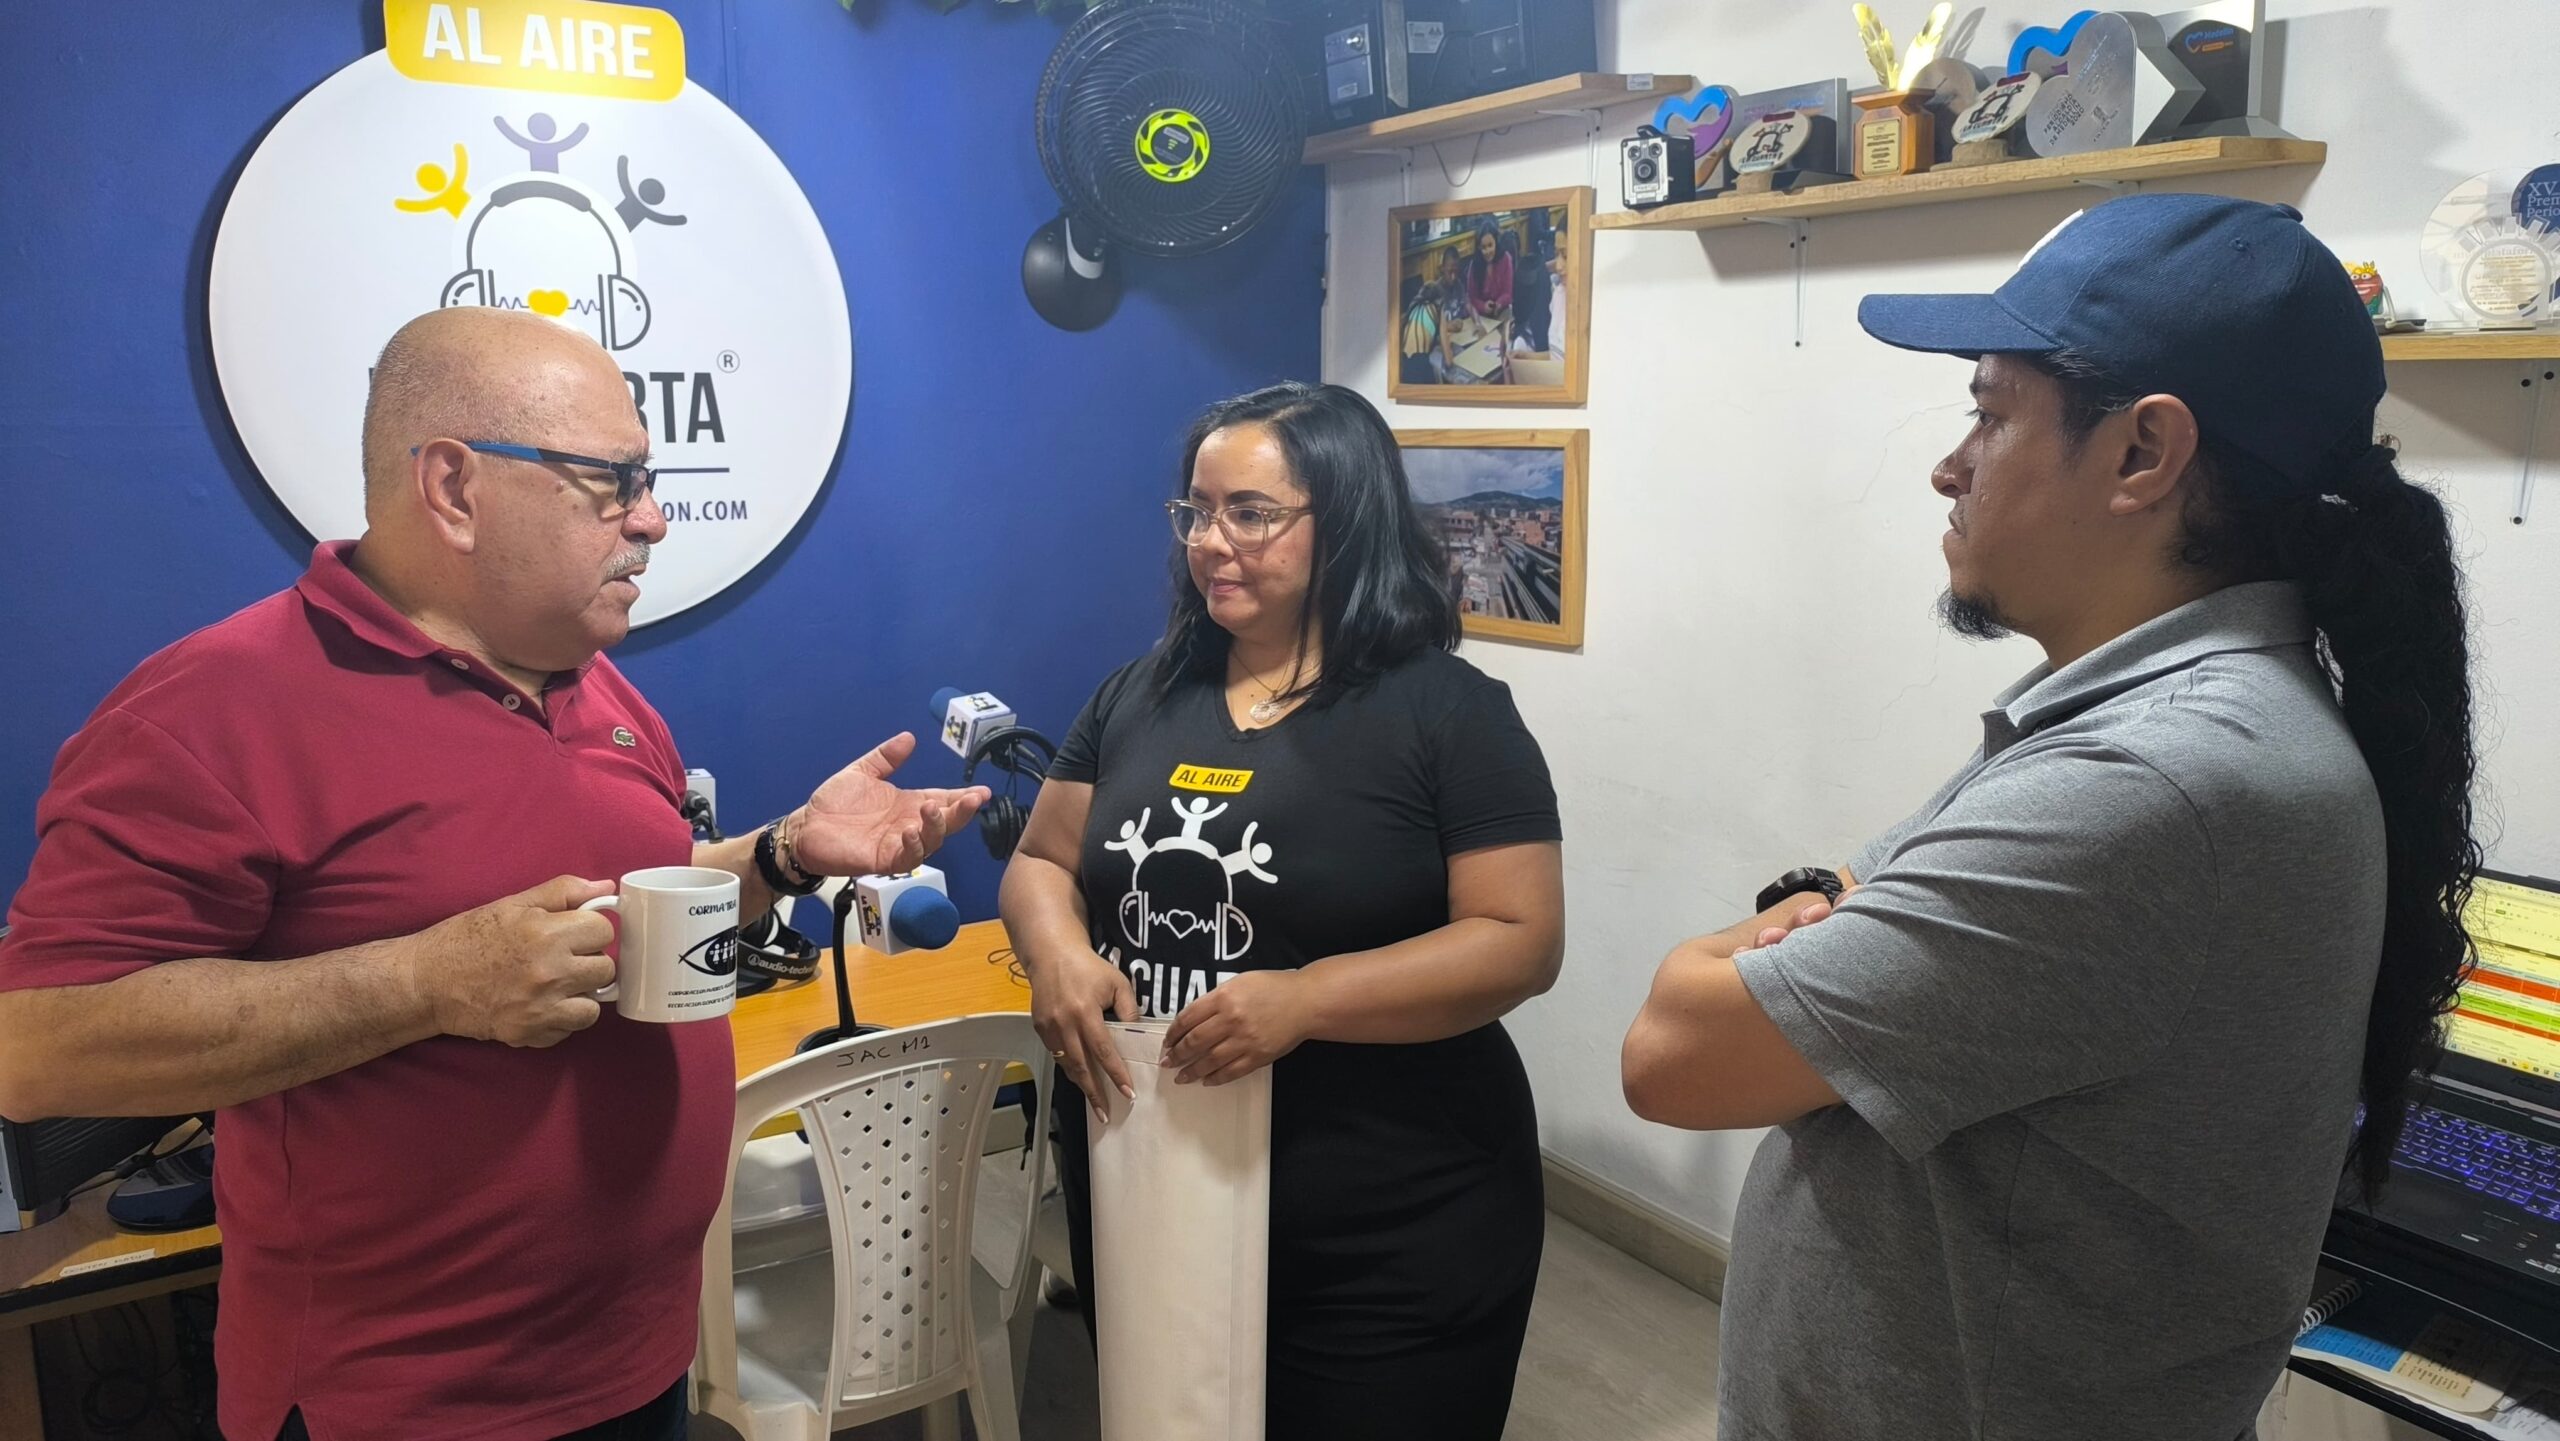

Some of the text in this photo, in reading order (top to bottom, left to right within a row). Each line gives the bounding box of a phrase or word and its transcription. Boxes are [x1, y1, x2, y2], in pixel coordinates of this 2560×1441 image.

[423, 4, 654, 79] AL AIRE
[1177, 769, 1246, 787] AL AIRE
